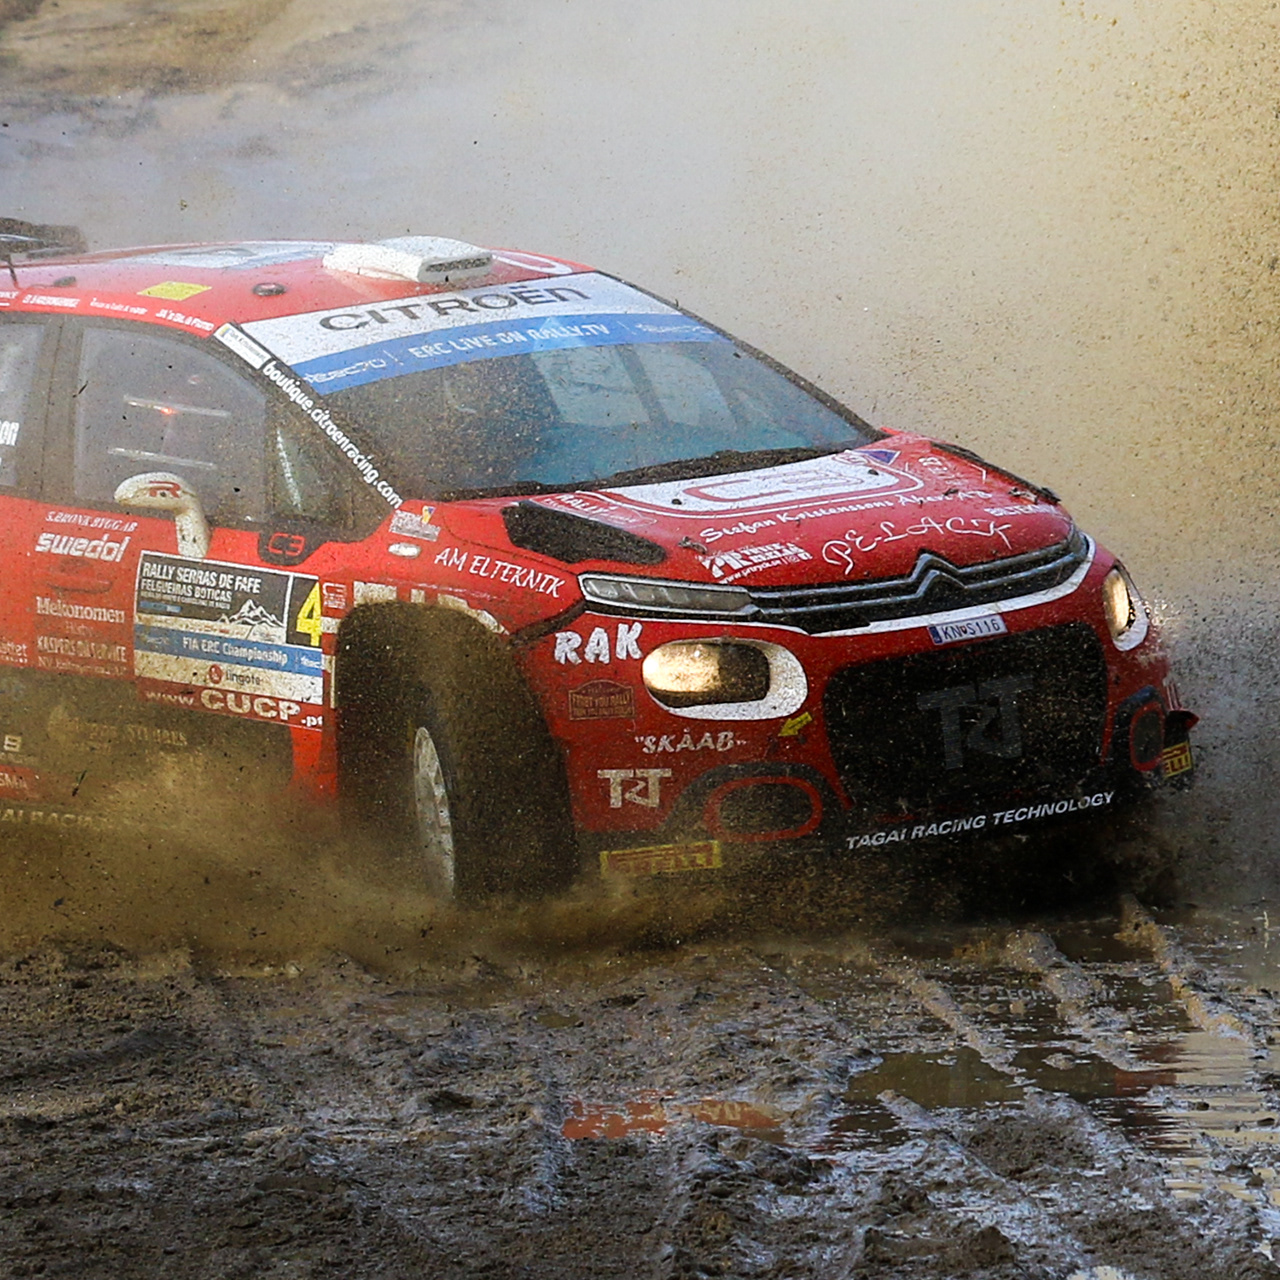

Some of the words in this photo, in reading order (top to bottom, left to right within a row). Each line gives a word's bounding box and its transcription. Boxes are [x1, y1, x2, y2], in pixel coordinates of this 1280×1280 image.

[319, 286, 592, 331] CITROËN
[408, 342, 453, 359] ERC
[453, 335, 493, 353] LIVE
[501, 330, 528, 345] ON
[529, 323, 611, 341] RALLY.TV
[263, 361, 403, 508] boutique.citroenracing.com
[35, 532, 131, 562] swedol
[700, 519, 777, 543] Stefan
[433, 547, 469, 571] AM
[140, 578, 192, 597] FELGUEIRAS
[194, 586, 233, 603] BOTICAS
[141, 562, 174, 581] RALLY
[176, 567, 216, 588] SERRAS
[219, 573, 234, 590] DE
[234, 575, 261, 594] FAFE
[36, 596, 126, 623] Mekonomen
[296, 581, 323, 647] 4
[182, 637, 199, 651] FIA
[201, 639, 220, 654] ERC
[222, 642, 288, 666] Championship
[554, 621, 644, 666] RAK
[846, 828, 907, 850] TAGAI
[910, 815, 987, 839] RACING
[993, 791, 1115, 826] TECHNOLOGY
